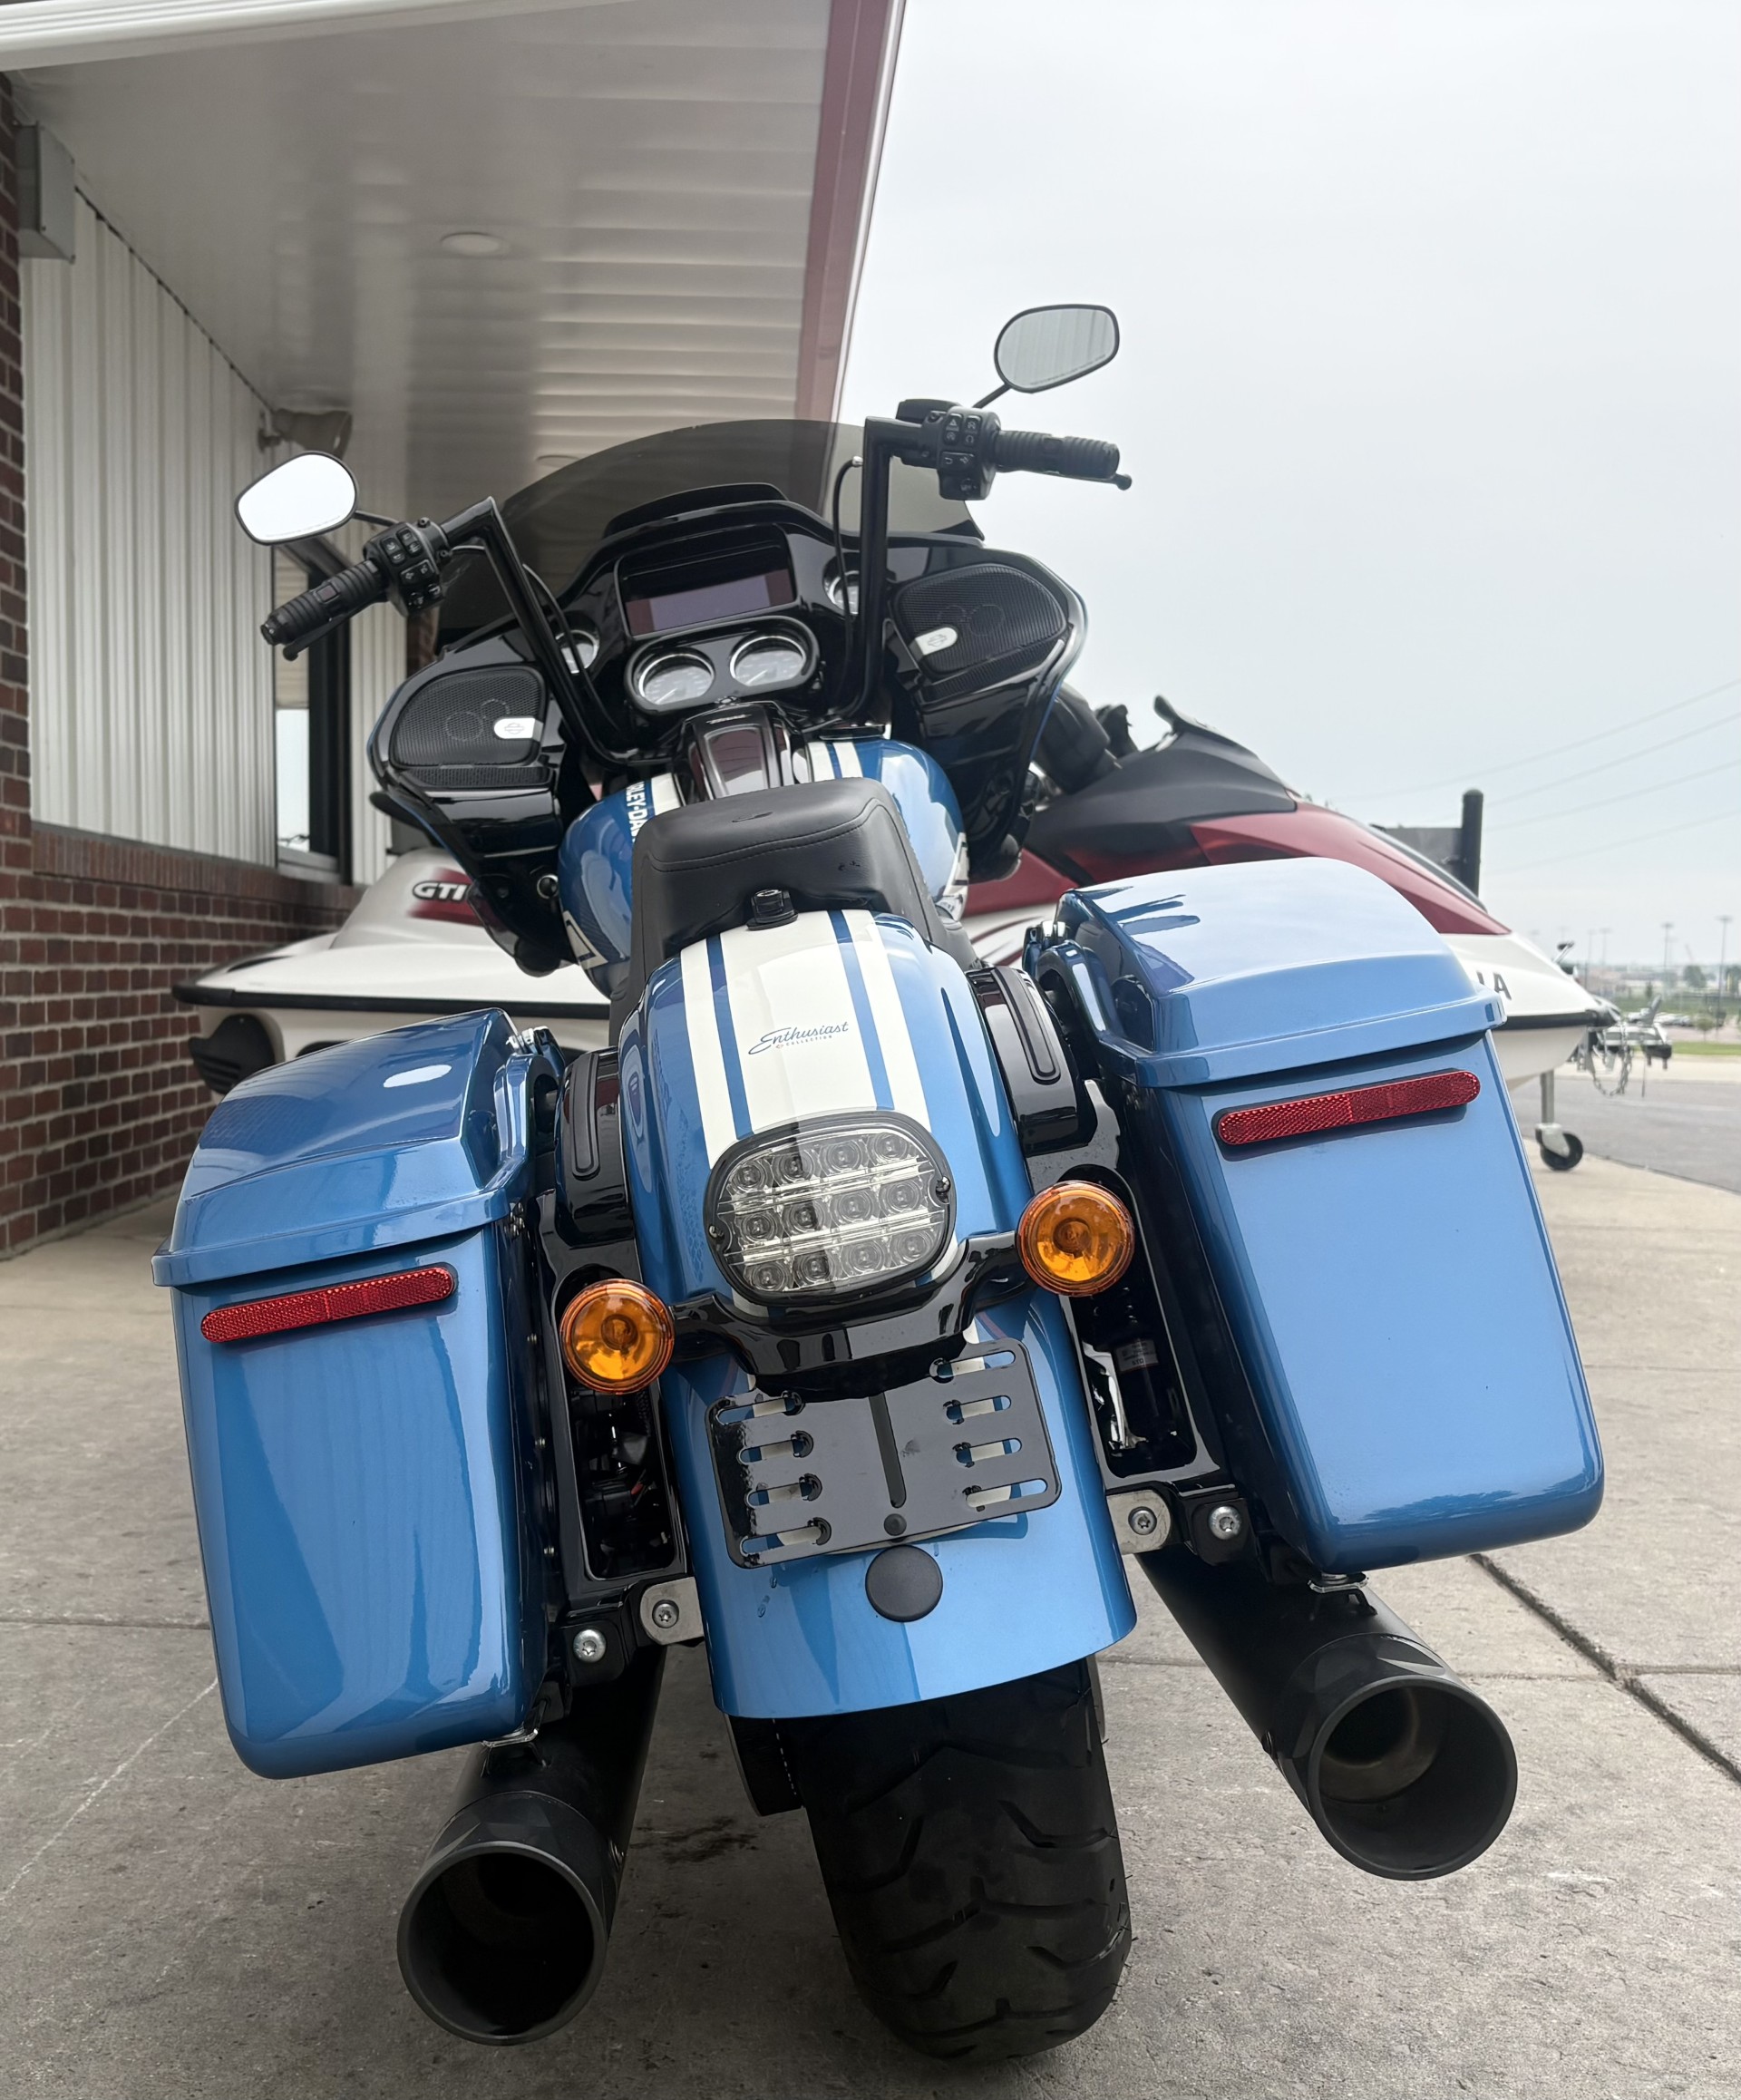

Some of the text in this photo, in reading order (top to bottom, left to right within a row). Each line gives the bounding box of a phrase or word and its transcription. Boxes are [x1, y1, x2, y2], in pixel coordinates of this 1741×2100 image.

[413, 881, 469, 901] GTI
[748, 1021, 849, 1055] Enthusiast
[786, 1035, 832, 1046] COLLECTION
